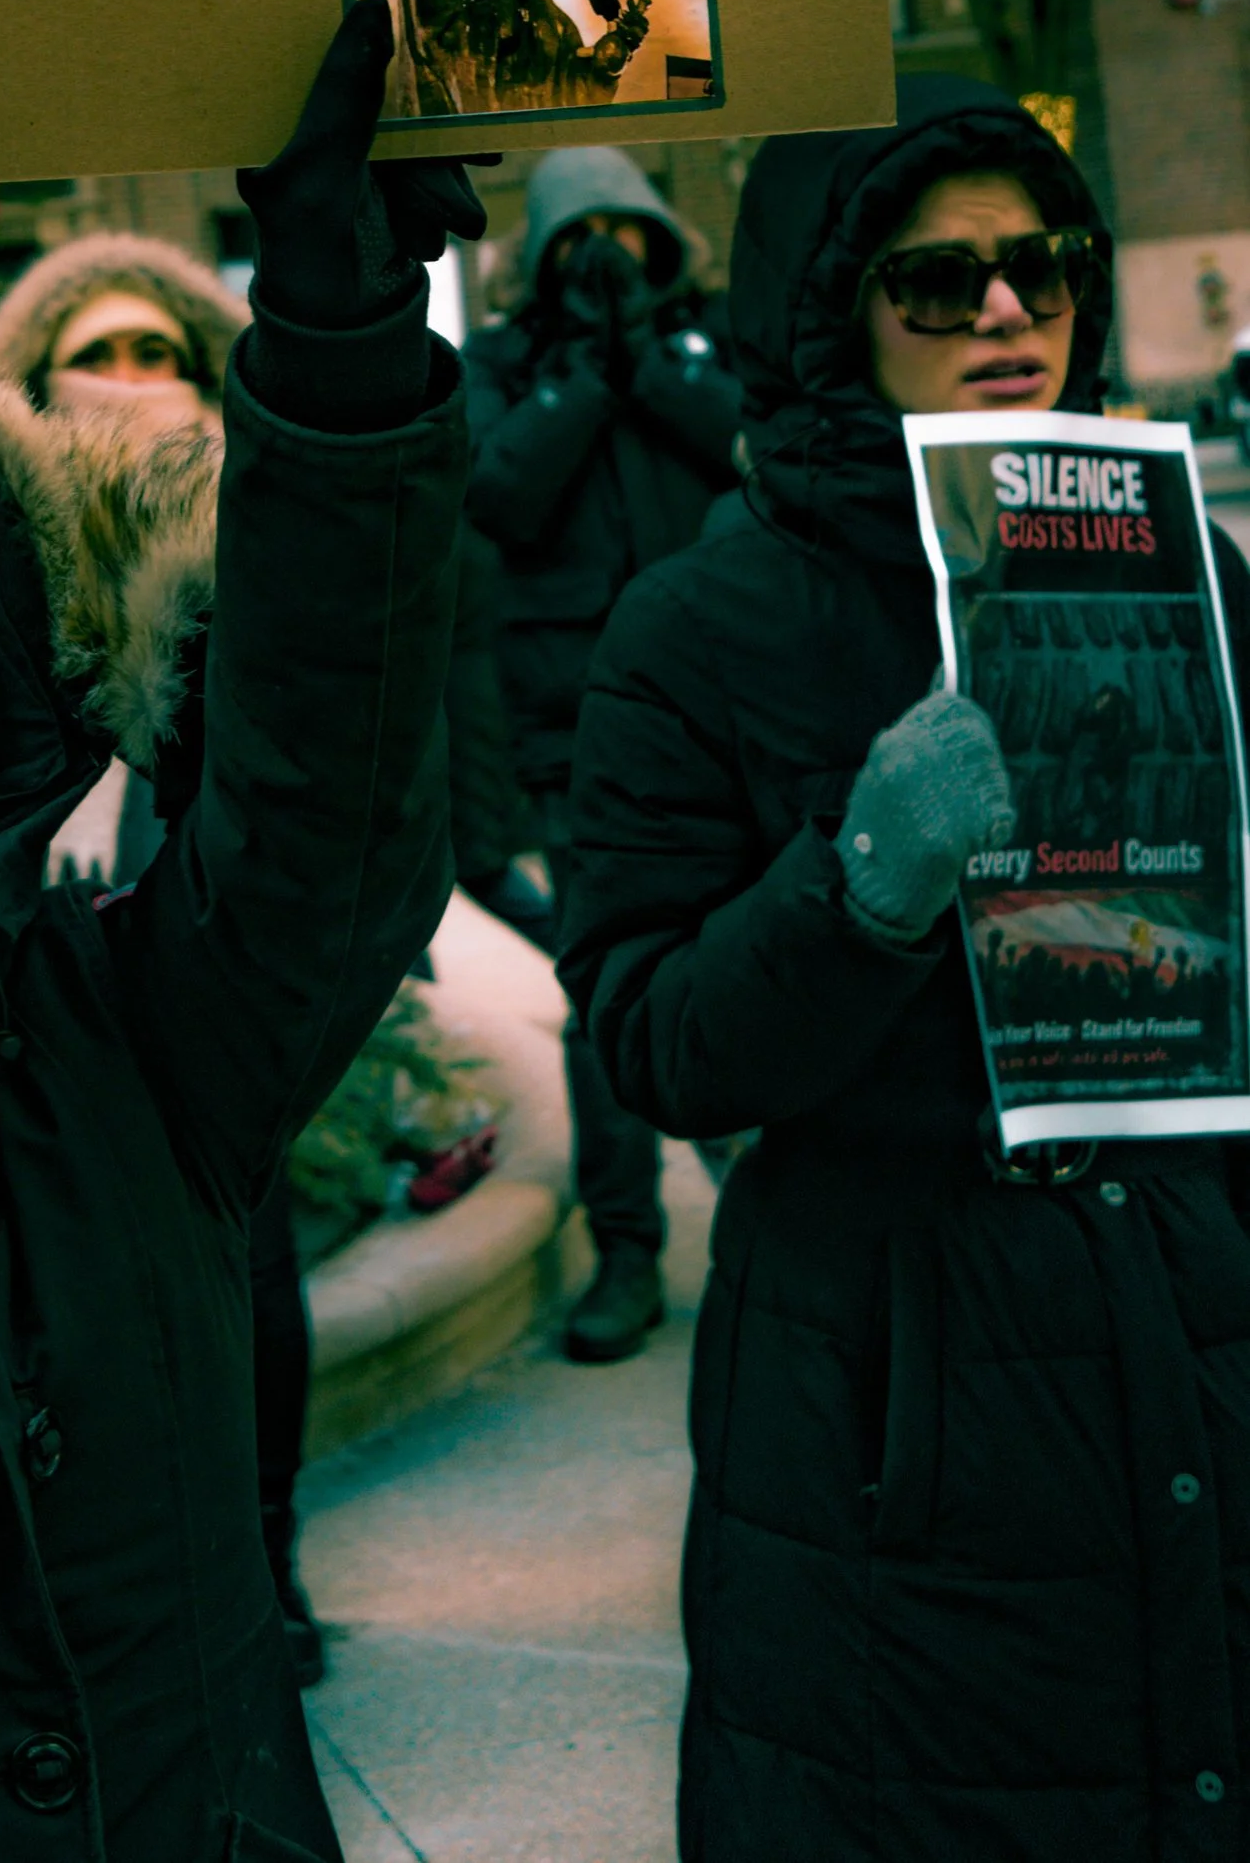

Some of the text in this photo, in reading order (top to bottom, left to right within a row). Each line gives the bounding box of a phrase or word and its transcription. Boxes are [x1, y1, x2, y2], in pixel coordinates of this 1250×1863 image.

[991, 451, 1148, 513] SILENCE
[998, 511, 1157, 555] COSTS LIVES
[1037, 840, 1119, 874] Second
[1125, 837, 1203, 875] Counts
